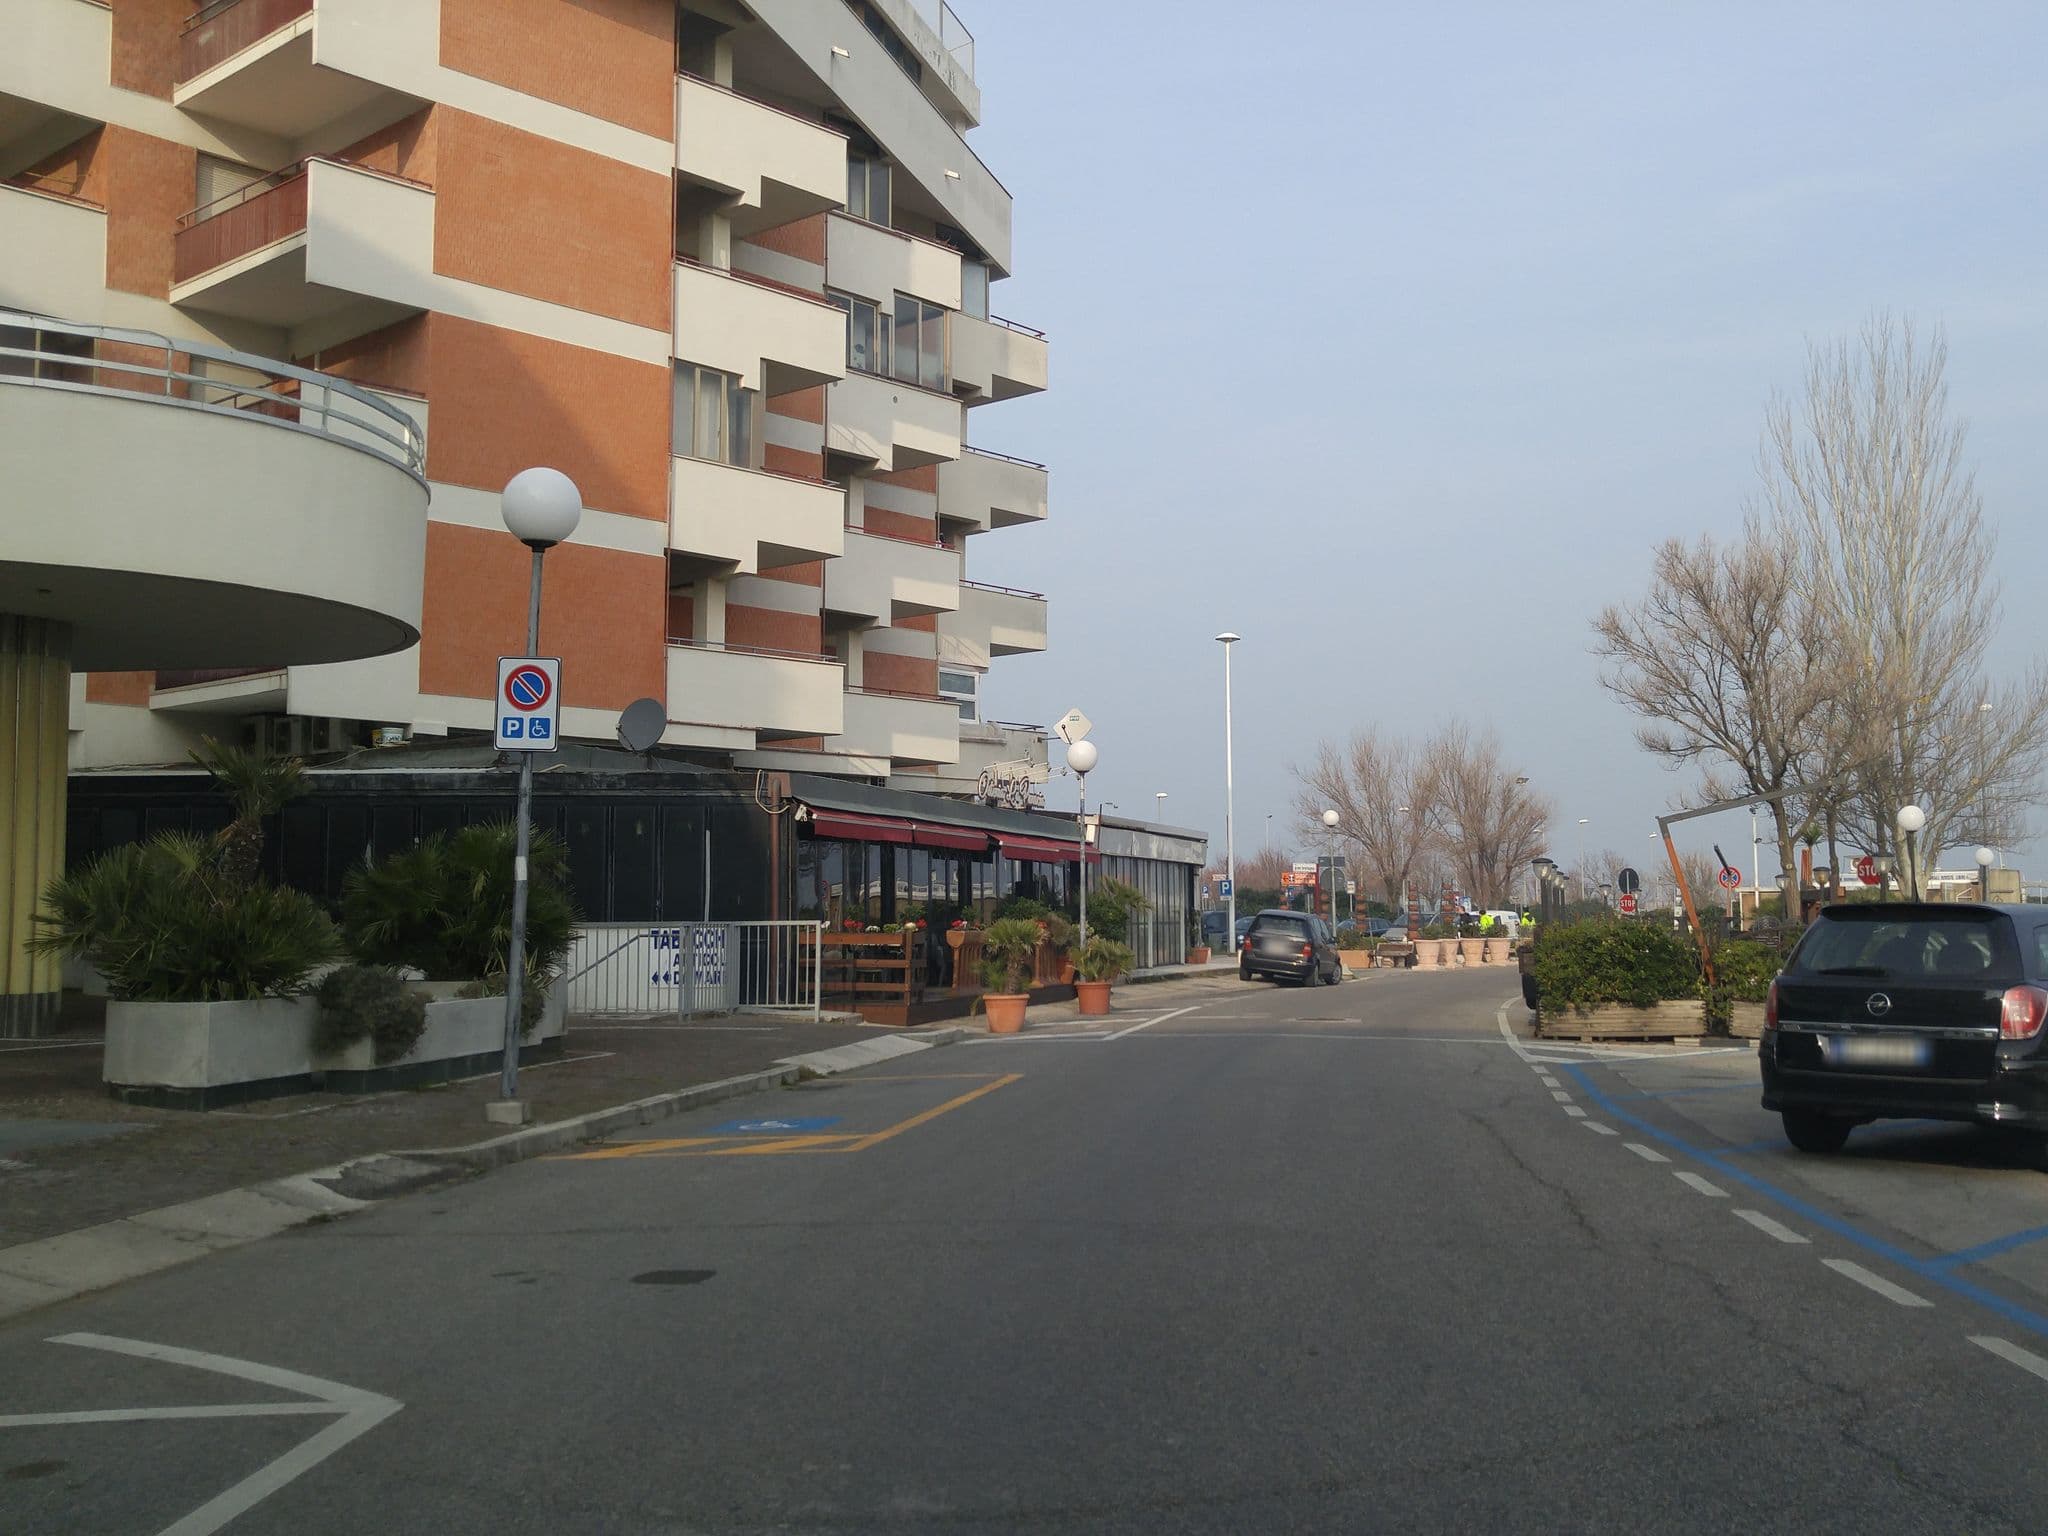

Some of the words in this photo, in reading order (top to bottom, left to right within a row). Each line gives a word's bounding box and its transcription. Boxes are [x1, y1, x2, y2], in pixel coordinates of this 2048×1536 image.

[507, 719, 520, 736] P
[1858, 865, 1880, 877] STO
[1221, 881, 1230, 894] P
[1620, 899, 1636, 908] STOP
